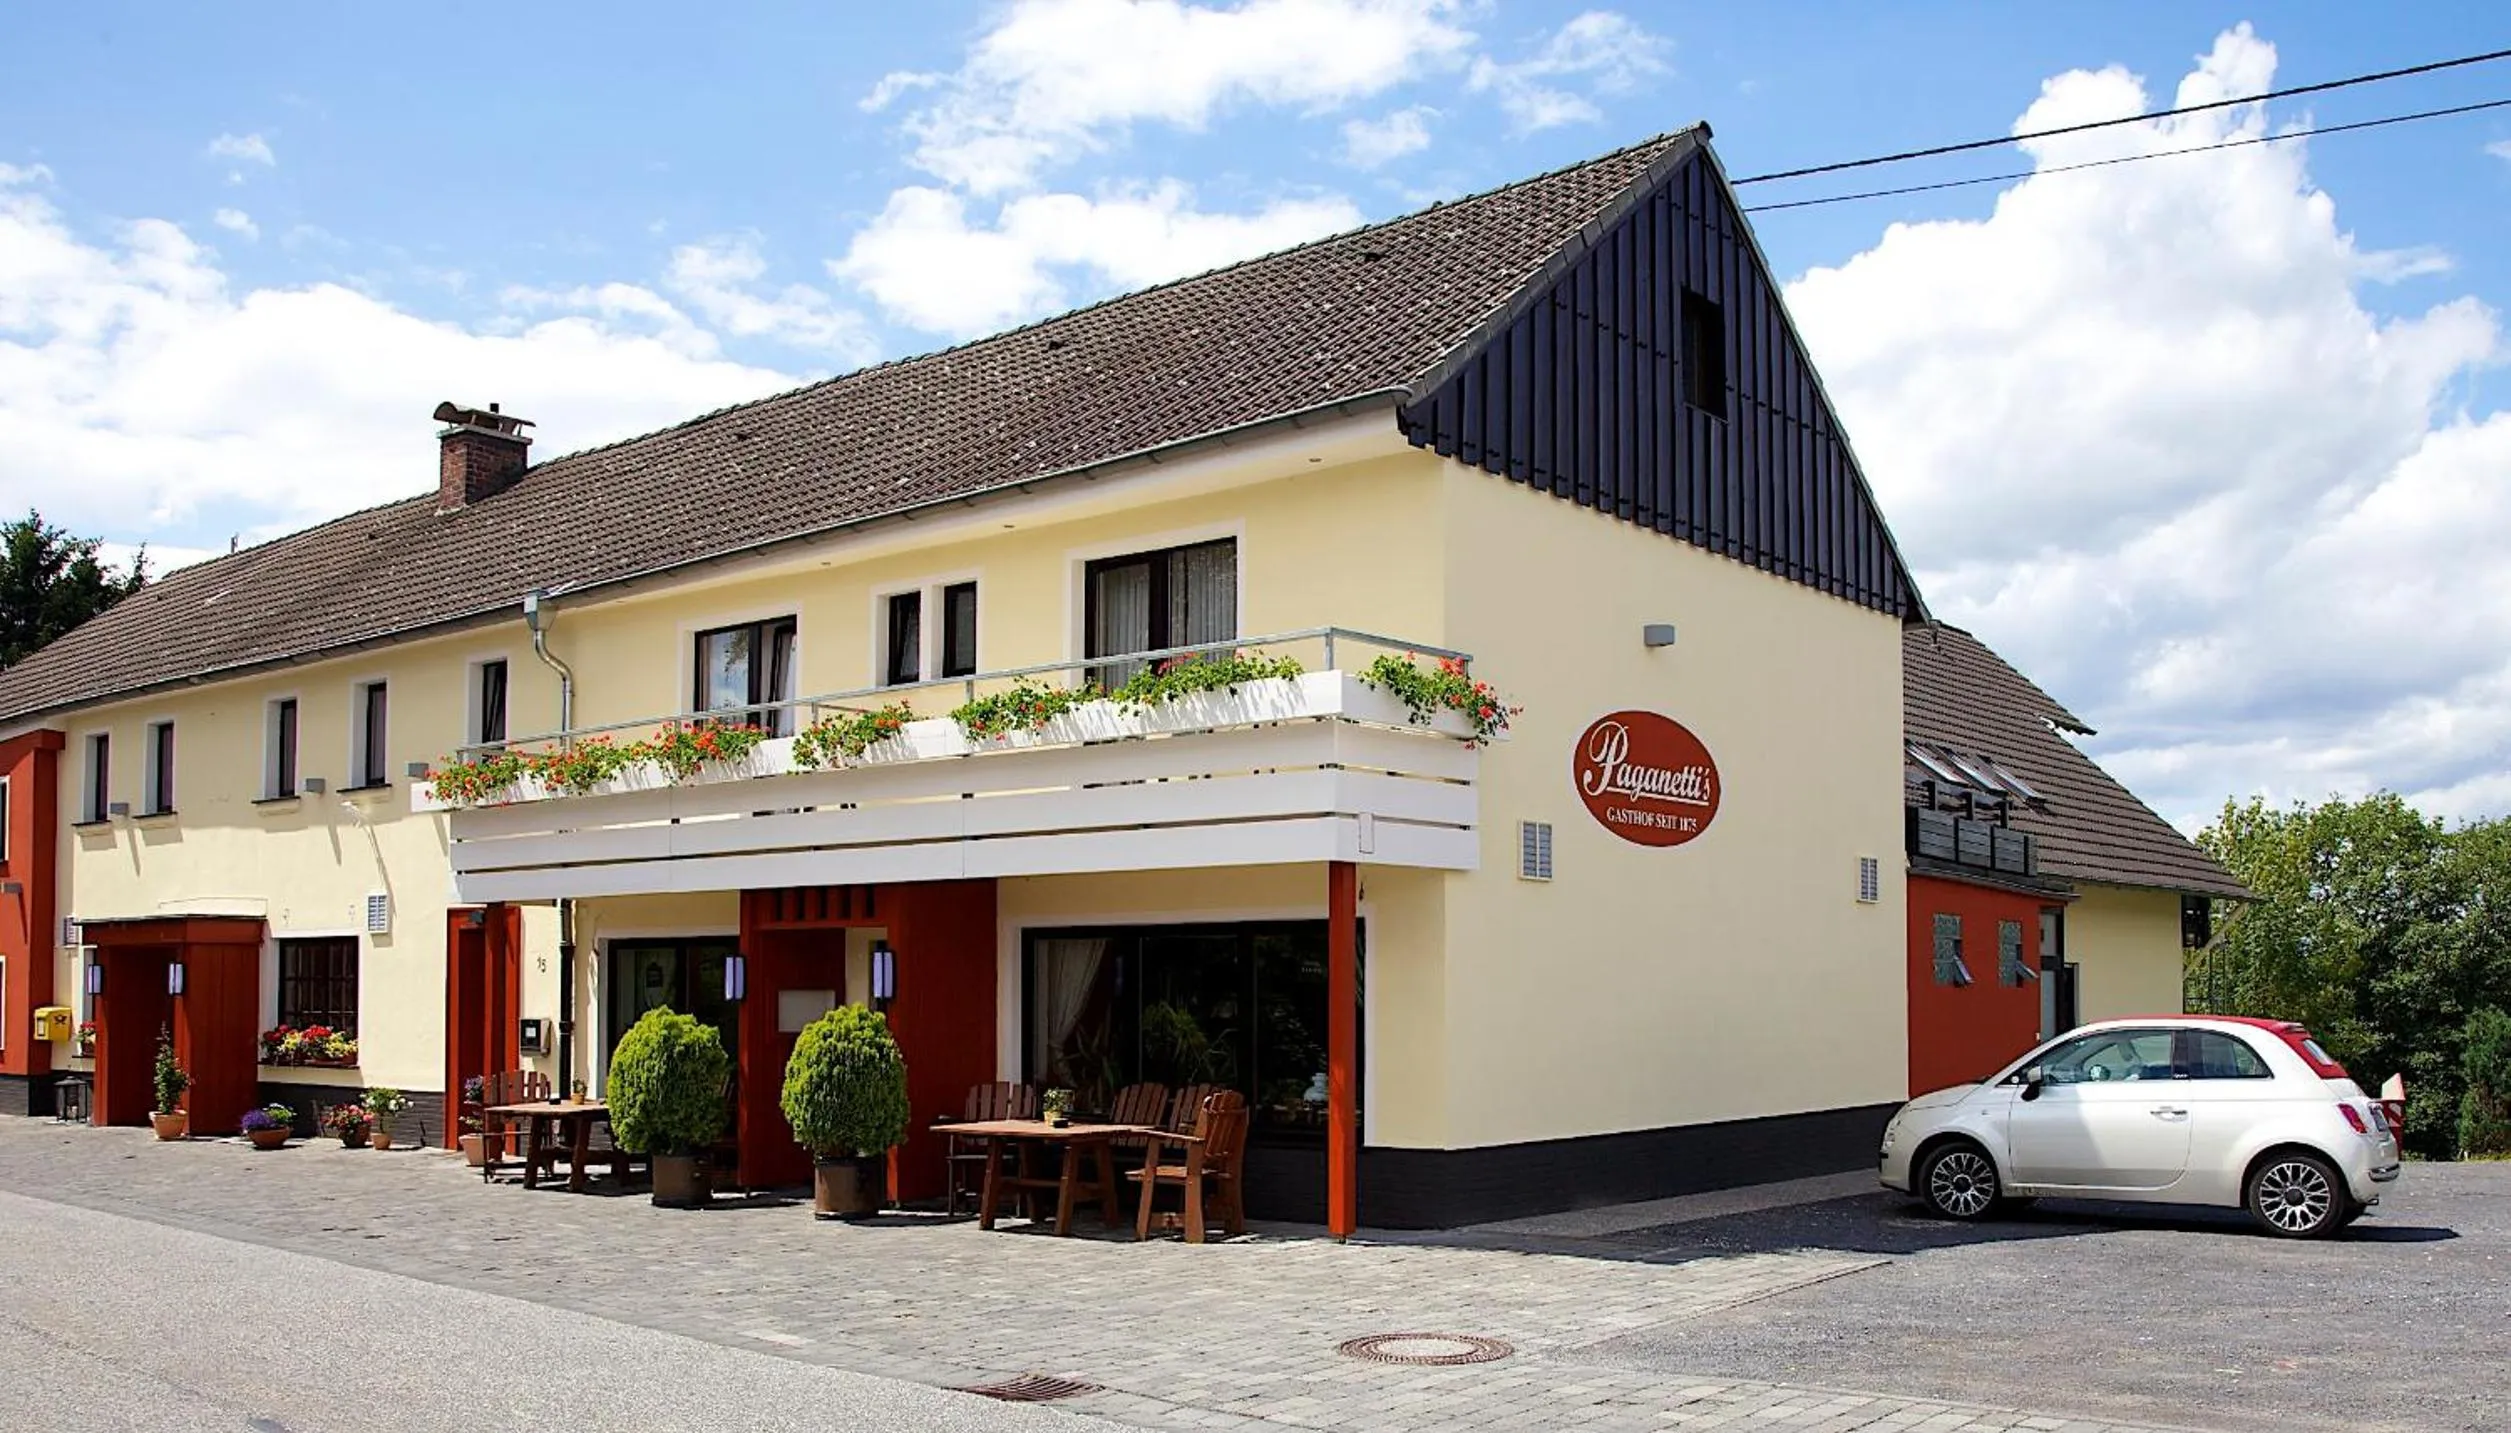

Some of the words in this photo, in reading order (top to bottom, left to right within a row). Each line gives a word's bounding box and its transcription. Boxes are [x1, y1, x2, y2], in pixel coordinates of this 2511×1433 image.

[1583, 721, 1710, 803] Paganetti's
[1606, 806, 1654, 827] GASTHOF
[1655, 812, 1677, 829] SEIT
